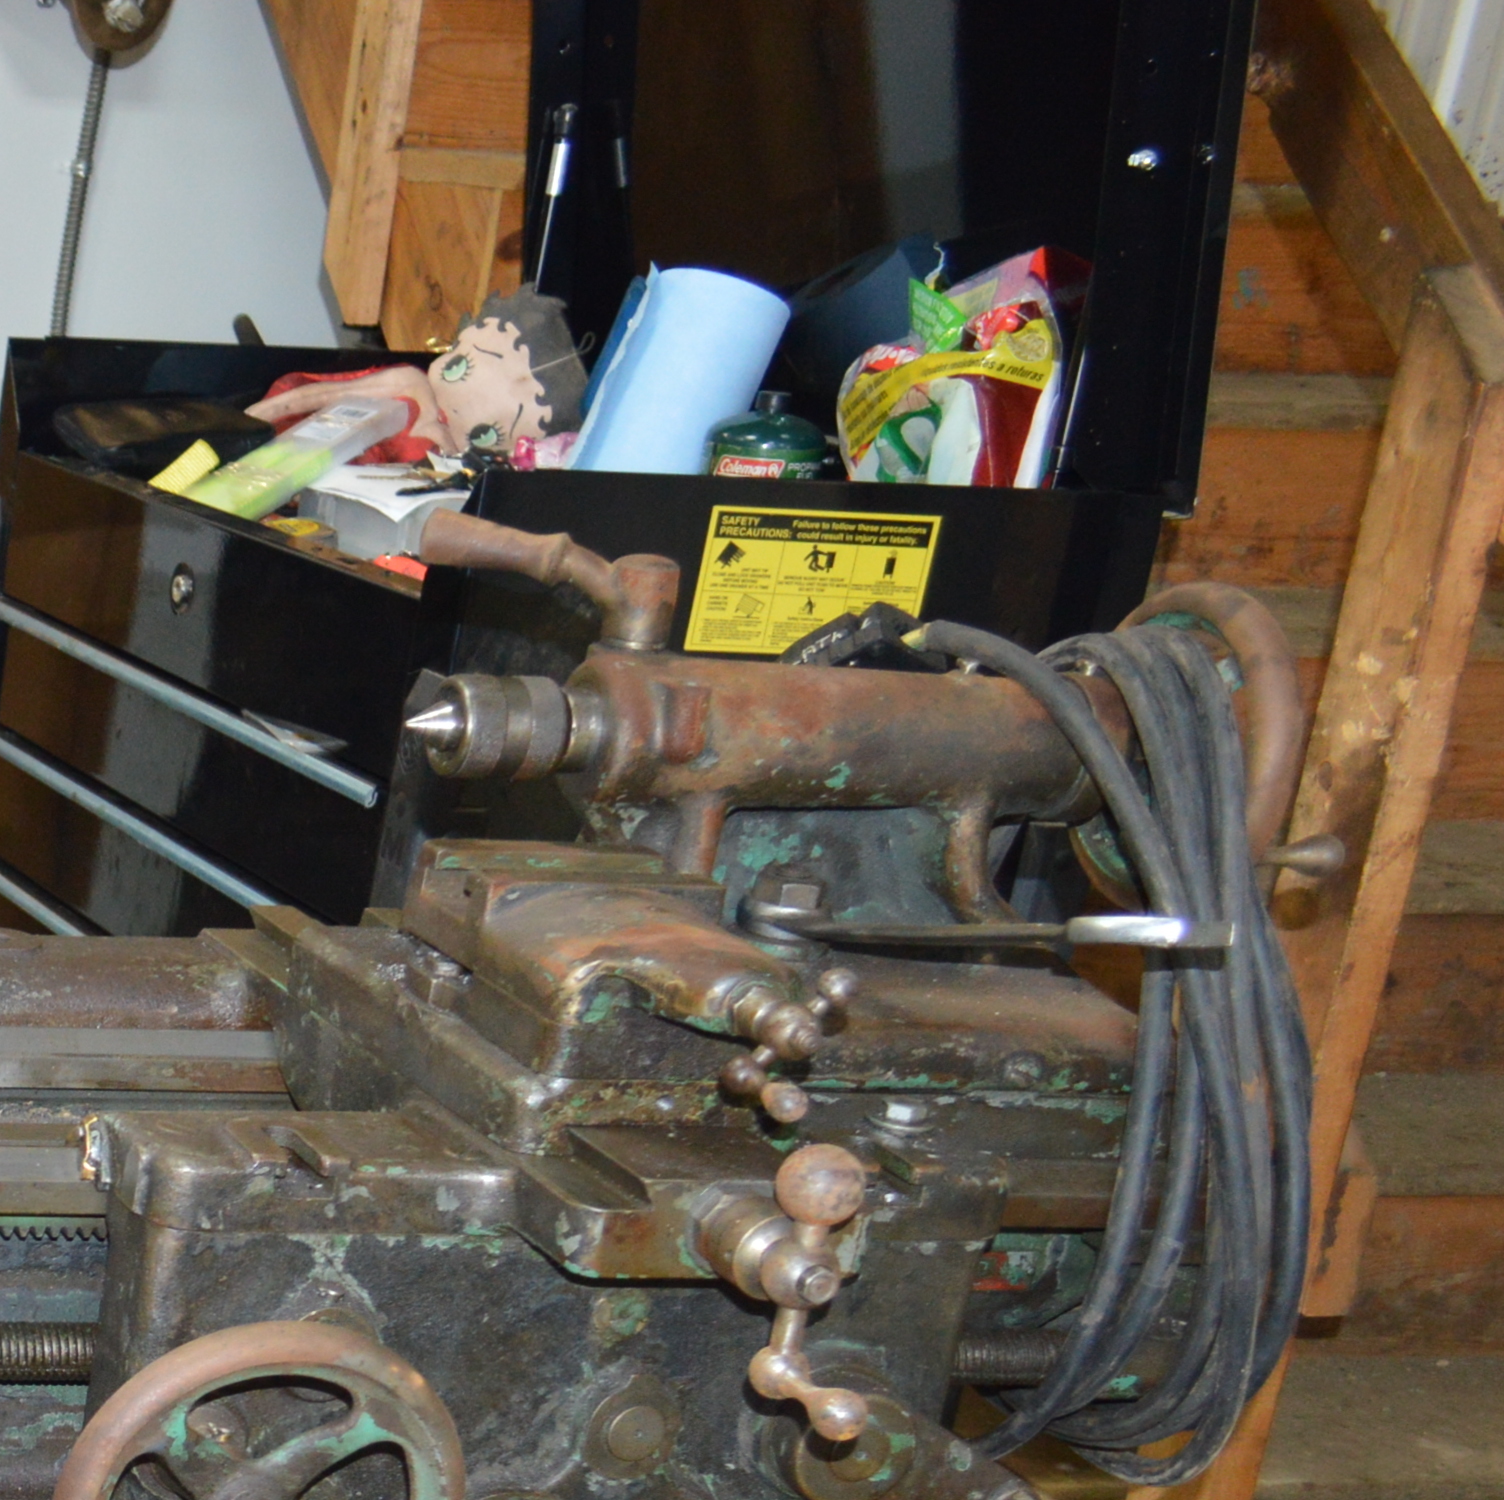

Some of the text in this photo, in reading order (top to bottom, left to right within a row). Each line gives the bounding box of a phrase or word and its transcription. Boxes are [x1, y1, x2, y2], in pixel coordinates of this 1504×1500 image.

[1005, 364, 1045, 383] roturas
[720, 459, 767, 476] Coleman
[721, 515, 760, 525] SAFETY
[793, 520, 927, 534] Failure to follow these precautions
[719, 526, 792, 539] PRECAUTIONS:
[796, 531, 820, 540] could
[821, 532, 844, 541] result
[854, 533, 878, 544] injury
[889, 535, 917, 545] fatality.
